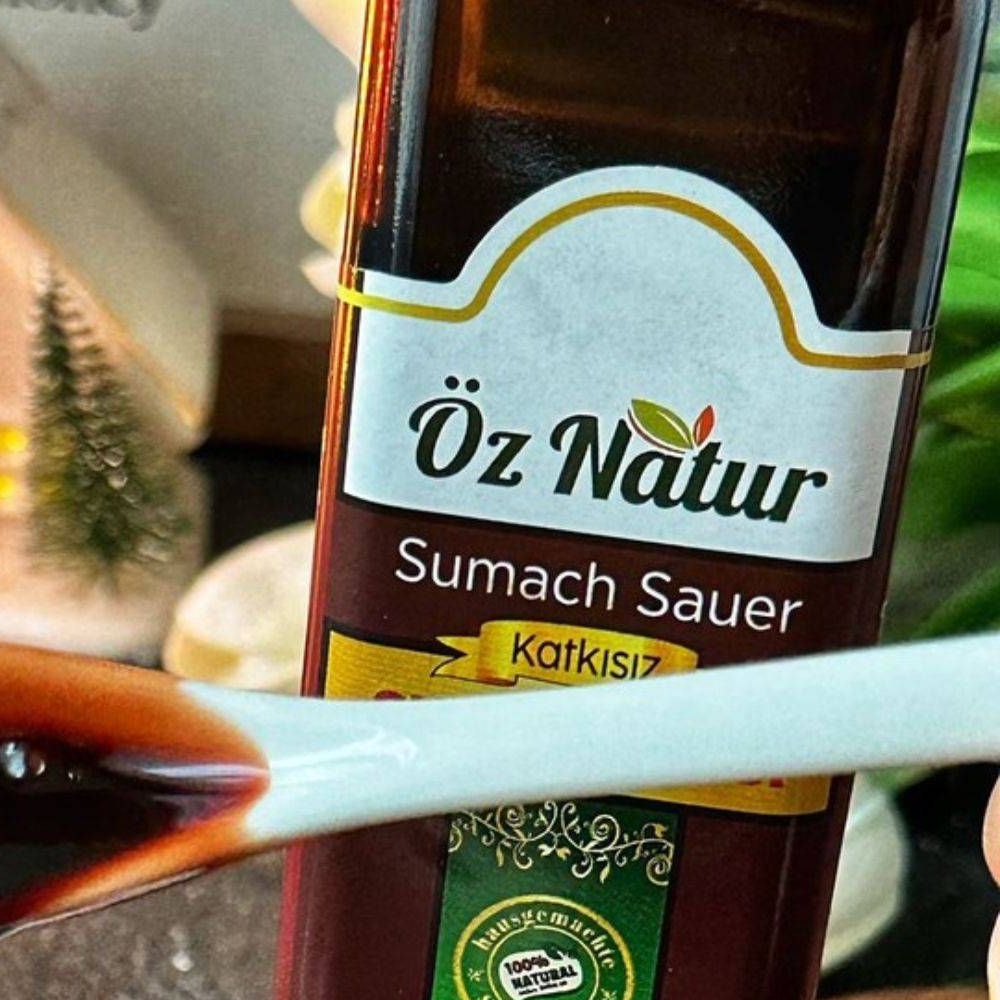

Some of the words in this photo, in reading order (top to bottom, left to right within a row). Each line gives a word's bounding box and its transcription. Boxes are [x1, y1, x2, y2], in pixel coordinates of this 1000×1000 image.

[409, 375, 532, 487] Öz
[550, 413, 828, 523] Natur
[395, 537, 617, 611] Sumach
[637, 571, 804, 634] Sauer
[503, 954, 550, 976] 100%
[511, 963, 579, 991] NATURAL
